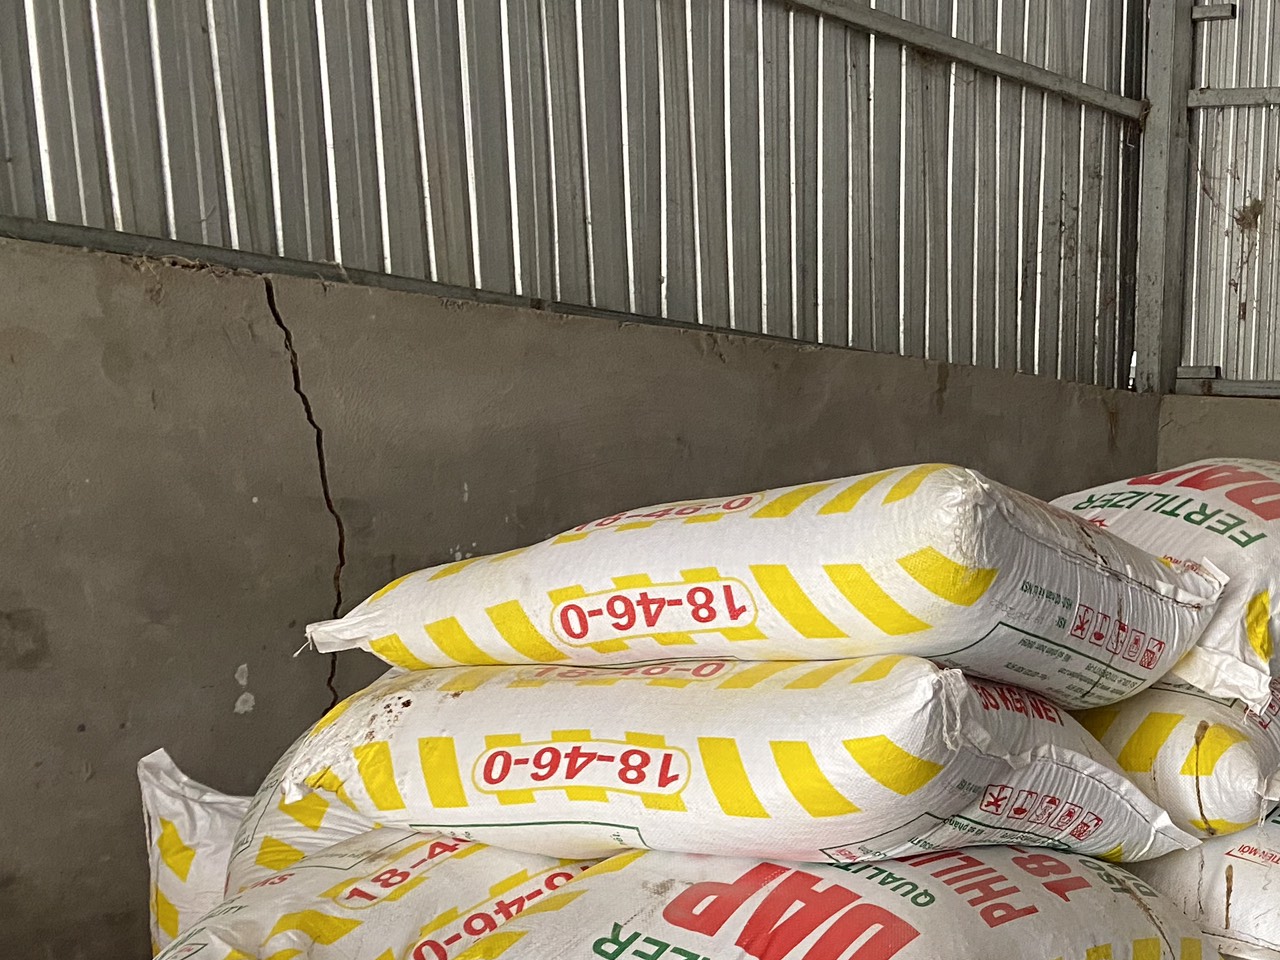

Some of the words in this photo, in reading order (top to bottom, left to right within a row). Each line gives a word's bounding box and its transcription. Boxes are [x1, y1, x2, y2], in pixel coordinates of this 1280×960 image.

[1073, 491, 1268, 548] FERTILIZER
[560, 585, 747, 639] 18-46-0
[483, 746, 679, 788] 18-46-0
